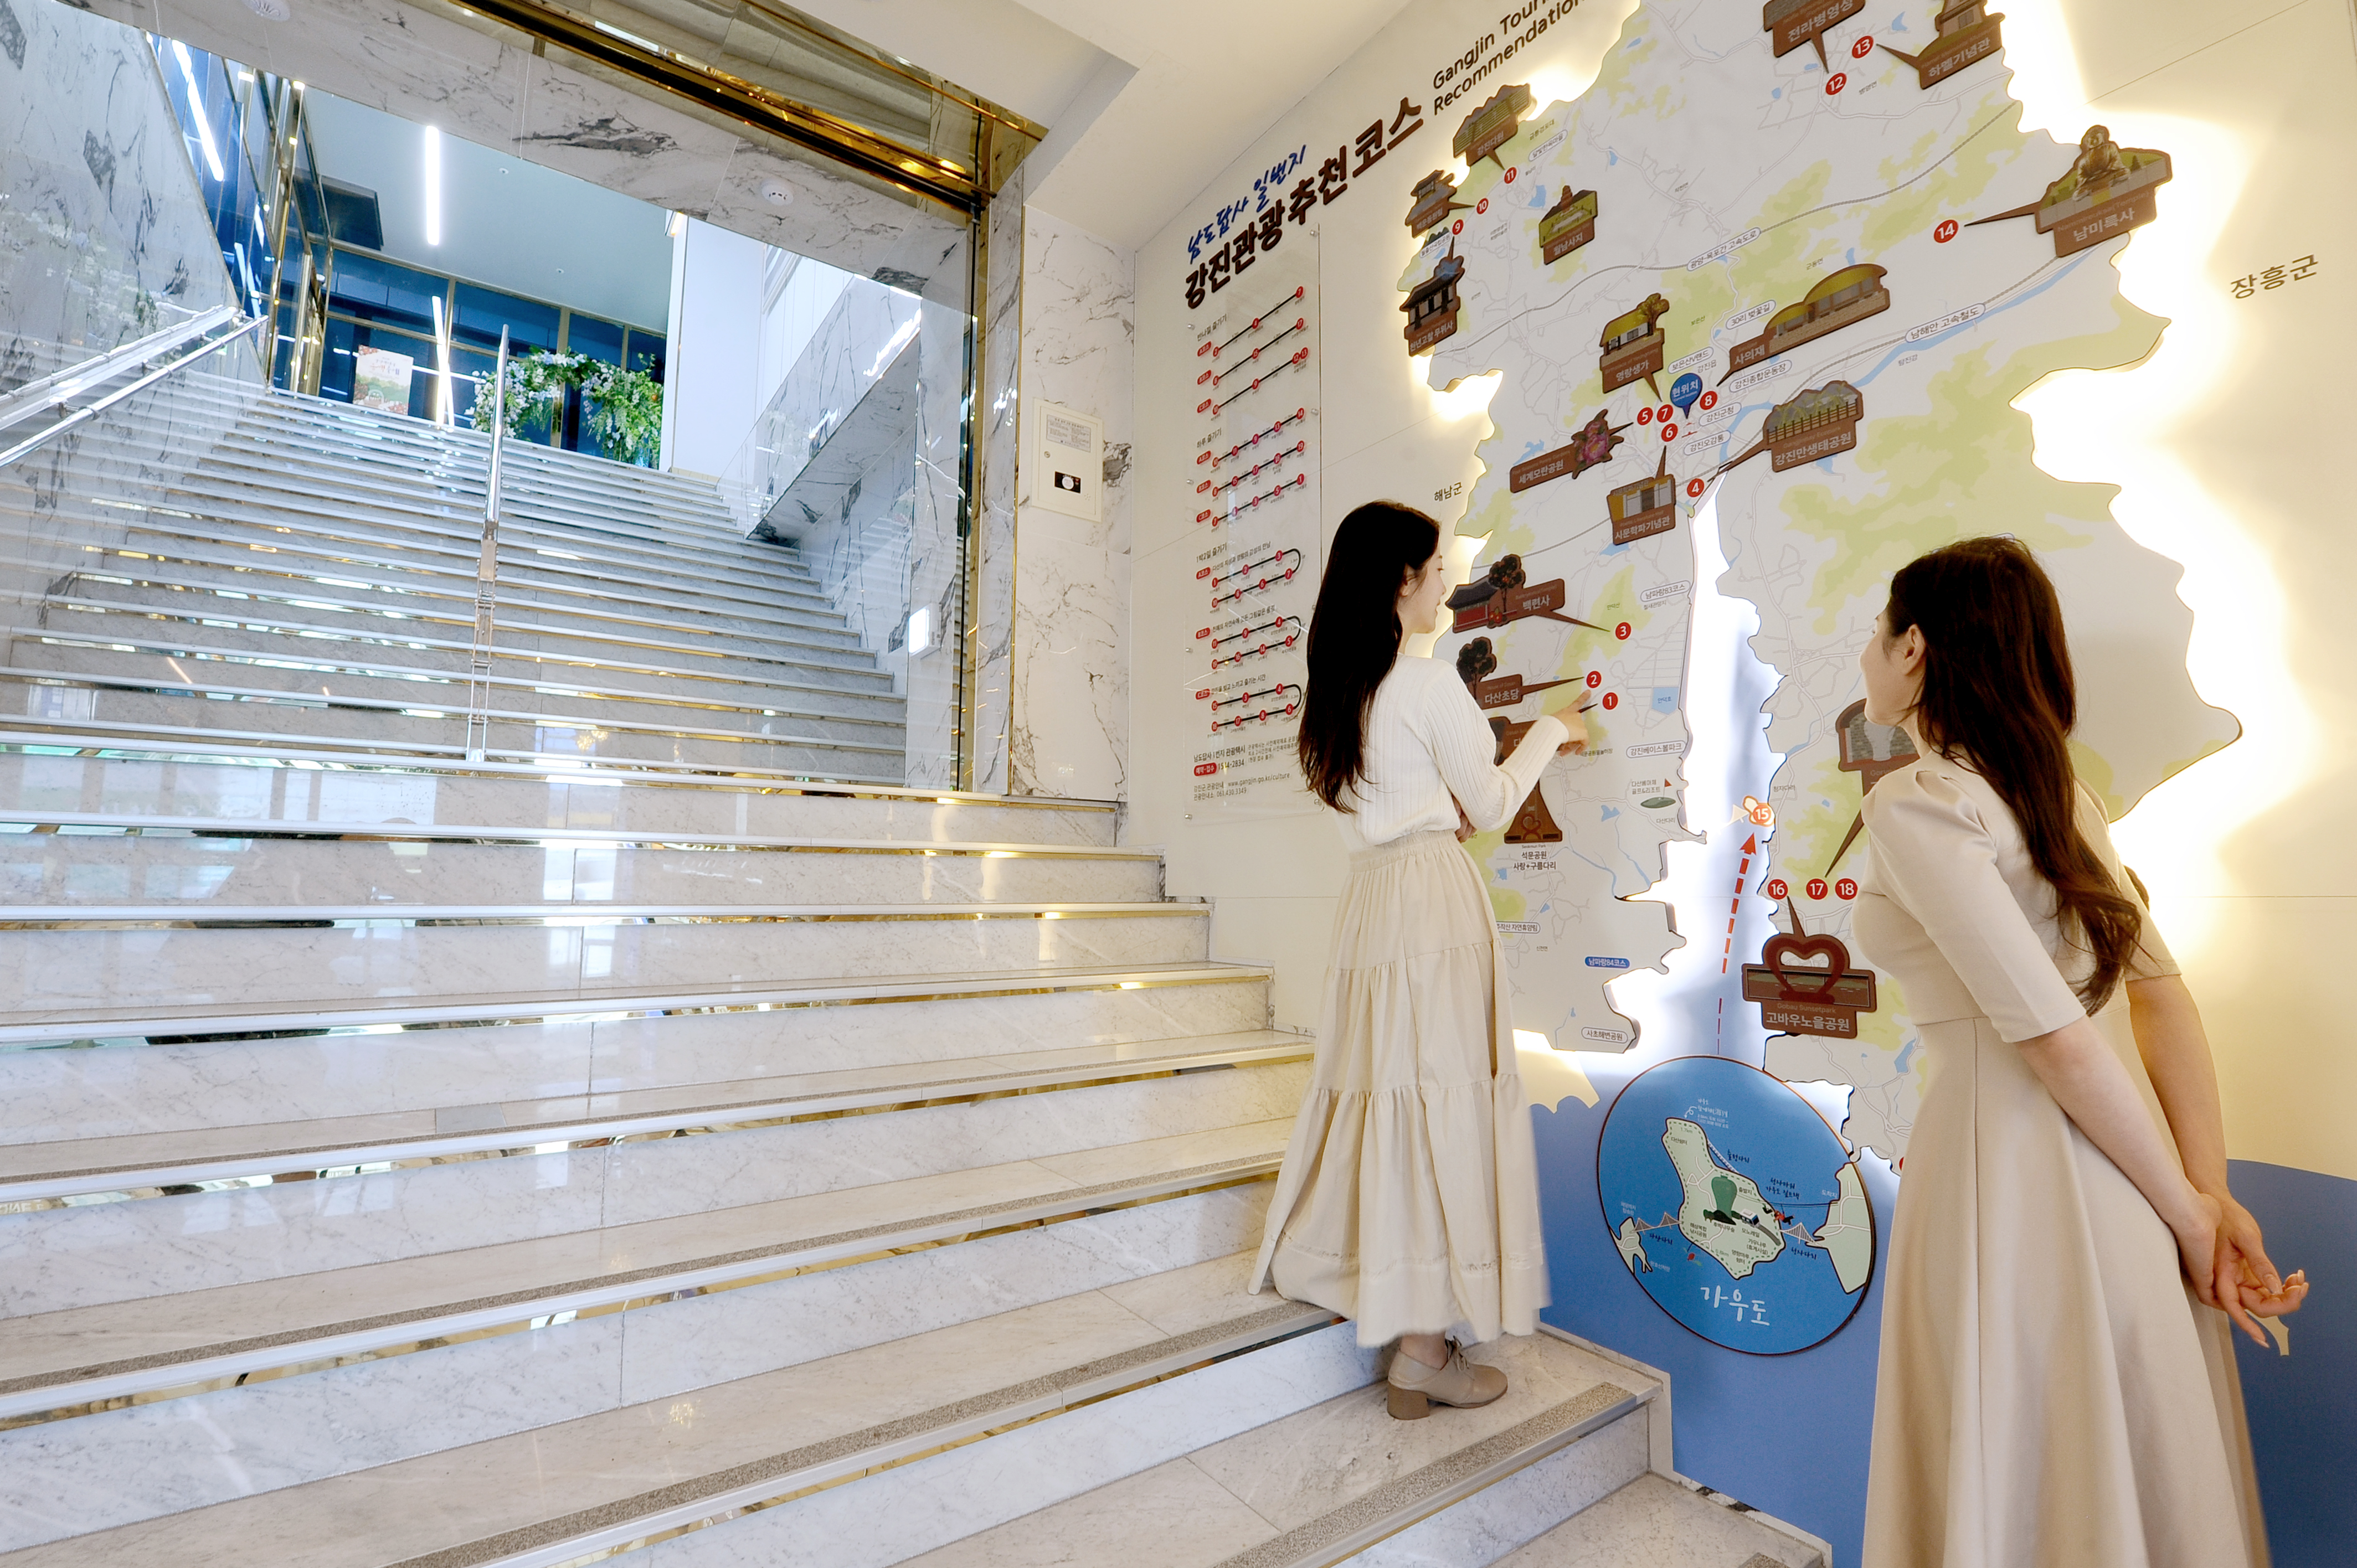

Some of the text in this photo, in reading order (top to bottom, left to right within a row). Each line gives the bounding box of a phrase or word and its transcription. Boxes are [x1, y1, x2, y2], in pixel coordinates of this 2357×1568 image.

[1788, 0, 1854, 43] 전라병영성
[1433, 0, 1551, 89] Gangjin Tour
[1855, 39, 1871, 55] 13
[1434, 0, 1584, 115] Recommendatio
[1928, 37, 1991, 78] 하멜기념관
[1829, 76, 1844, 92] 12
[1477, 131, 1505, 156] 강진다원
[1507, 169, 1514, 181] 11
[1188, 145, 1306, 264] 남도답사 일번지
[1479, 200, 1487, 212] 10
[1455, 222, 1461, 232] 9
[1938, 223, 1955, 239] 14
[2074, 208, 2135, 243] 남미륵사
[1553, 232, 1583, 256] 월남사지
[1690, 230, 1757, 269] 광양-목포간 고속도로
[2230, 254, 2318, 300] 장흥군
[1212, 313, 1227, 331] 즐기기
[1731, 303, 1771, 327] 30리 벚꽃길
[1911, 306, 1980, 340] 남해안 고속철도
[1434, 319, 1454, 338] 무위사
[1672, 350, 1709, 370] 보은산V랜드
[1734, 344, 1766, 365] 사의재
[1615, 360, 1649, 381] 영랑생가
[1697, 359, 1717, 374] 강진읍
[1734, 363, 1787, 390] 강진종합운동장
[1672, 379, 1699, 398] 현위치
[1705, 395, 1712, 406] 8
[1641, 410, 1649, 422] 5
[1661, 408, 1669, 420] 7
[1706, 406, 1734, 422] 강진군청
[1197, 427, 1222, 448] 하루 즐기기
[1666, 426, 1674, 438] 6
[1690, 434, 1725, 451] 강진오감통
[1776, 432, 1851, 466] 강진만생태공원
[1519, 460, 1564, 484] 세계모란공원
[1434, 482, 1462, 502] 해남군
[1691, 482, 1700, 493] 4
[1615, 516, 1670, 539] 시문학파기념관
[1196, 542, 1227, 563] 1박2일 즐기기
[1645, 584, 1685, 599] 남파랑83코스
[1523, 595, 1550, 611] 백련사
[1249, 608, 1266, 620] 그림같은
[1620, 626, 1627, 637] 3
[1232, 680, 1244, 689] 느끼고
[1244, 676, 1257, 686] 즐기는
[1591, 674, 1598, 685] 2
[1485, 689, 1519, 704] 다산초당
[1608, 695, 1612, 706] 1
[1194, 745, 1246, 762] 남도답사 1번지 관광택시
[1630, 742, 1682, 756] 강진베이스볼파크
[1194, 772, 1290, 793] 강진군 관광안내 www.gangjin.go.kr/culture
[1194, 787, 1247, 801] 관광안내소 061.430.3349
[1756, 808, 1769, 821] 15
[1521, 850, 1547, 860] 석문공원
[1513, 862, 1556, 871] 사랑+구름다리
[1771, 883, 1785, 896] 16
[1810, 883, 1824, 895] 17
[1839, 883, 1855, 896] 18
[1511, 924, 1538, 932] 자연휴양림
[1588, 957, 1626, 968] 남파랑84코스
[1767, 1012, 1850, 1033] 고바우노을공원
[1586, 1029, 1623, 1041] 사초해변공원
[1742, 1228, 1760, 1238] 모노레일
[1701, 1285, 1770, 1326] 가우도
